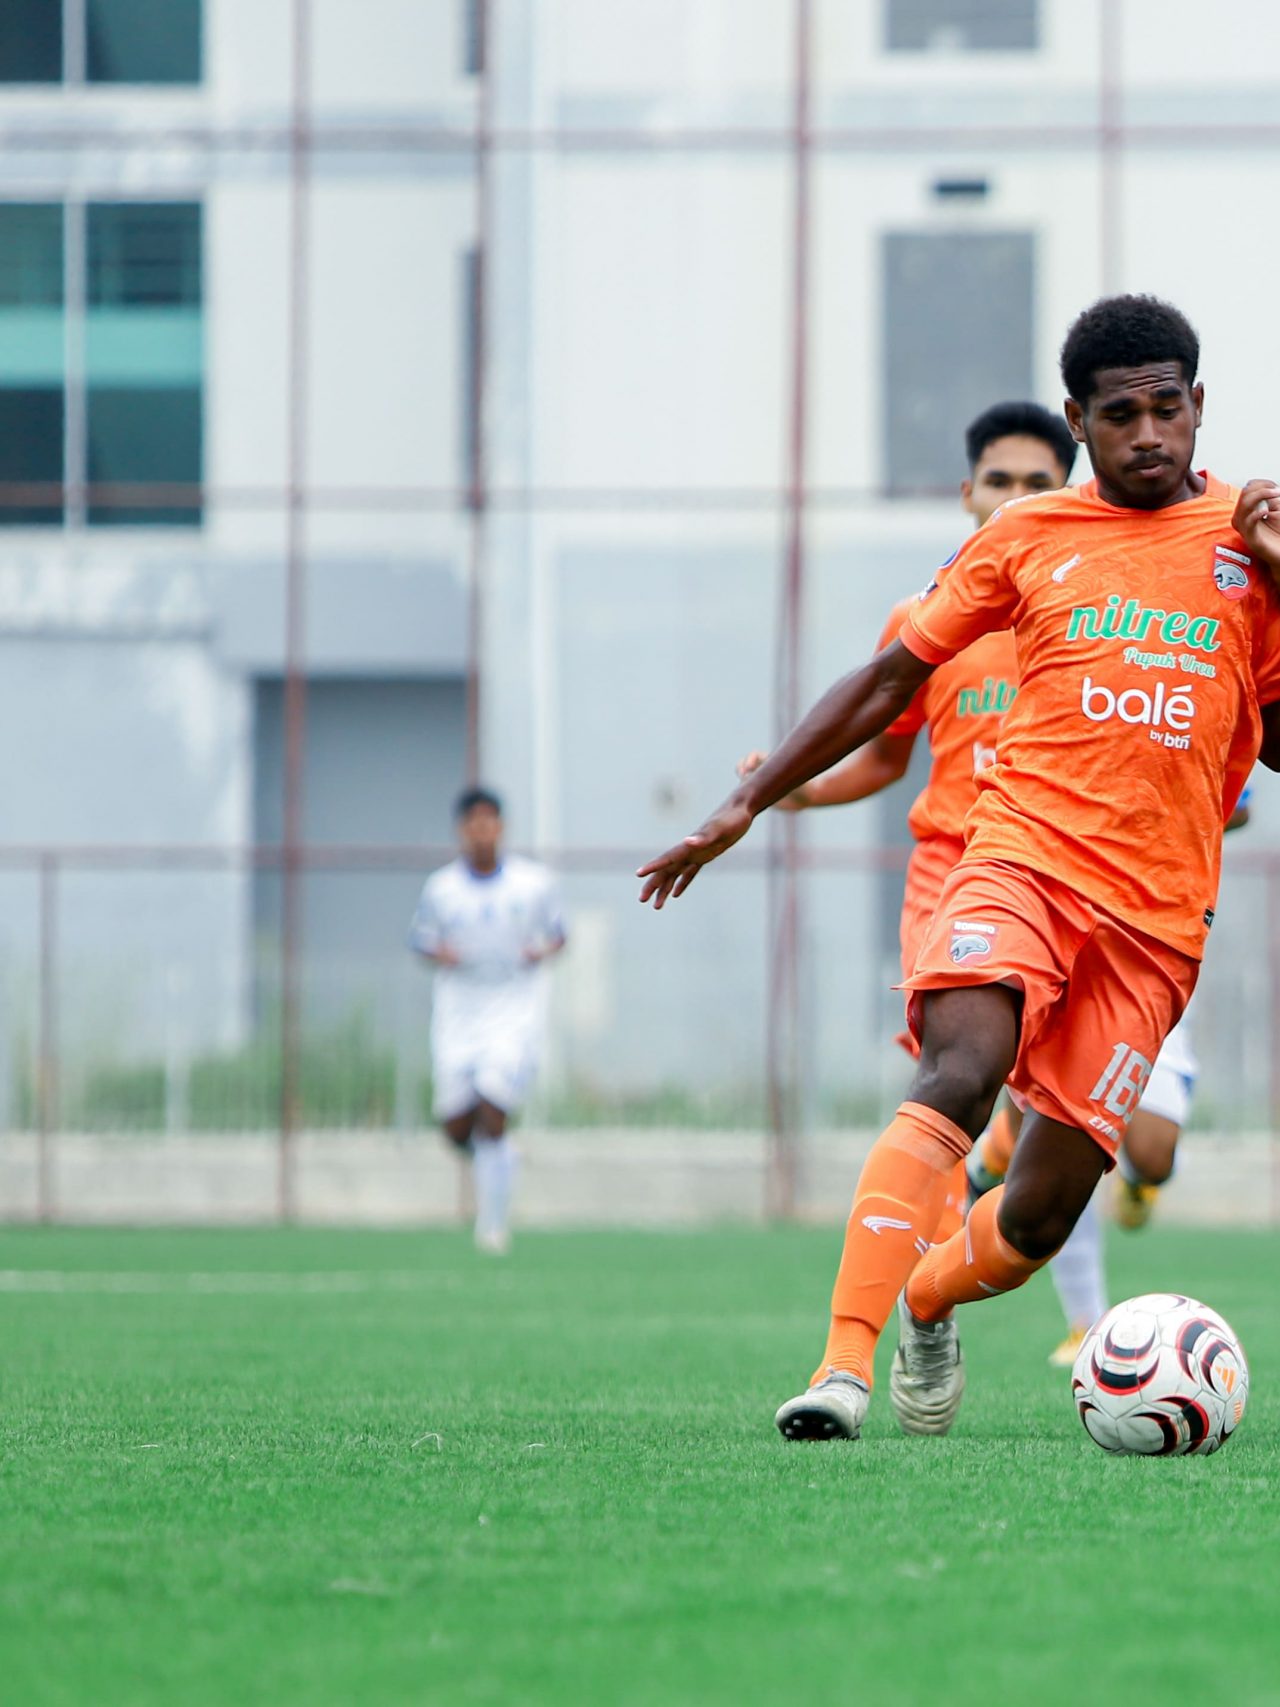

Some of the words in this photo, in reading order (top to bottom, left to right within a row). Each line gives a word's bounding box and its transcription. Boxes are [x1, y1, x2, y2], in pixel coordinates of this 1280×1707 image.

[1066, 595, 1221, 652] nitrea
[1123, 646, 1177, 670] Pupuk
[1178, 653, 1217, 679] Urea
[1081, 676, 1196, 730] balé
[1149, 729, 1164, 743] by
